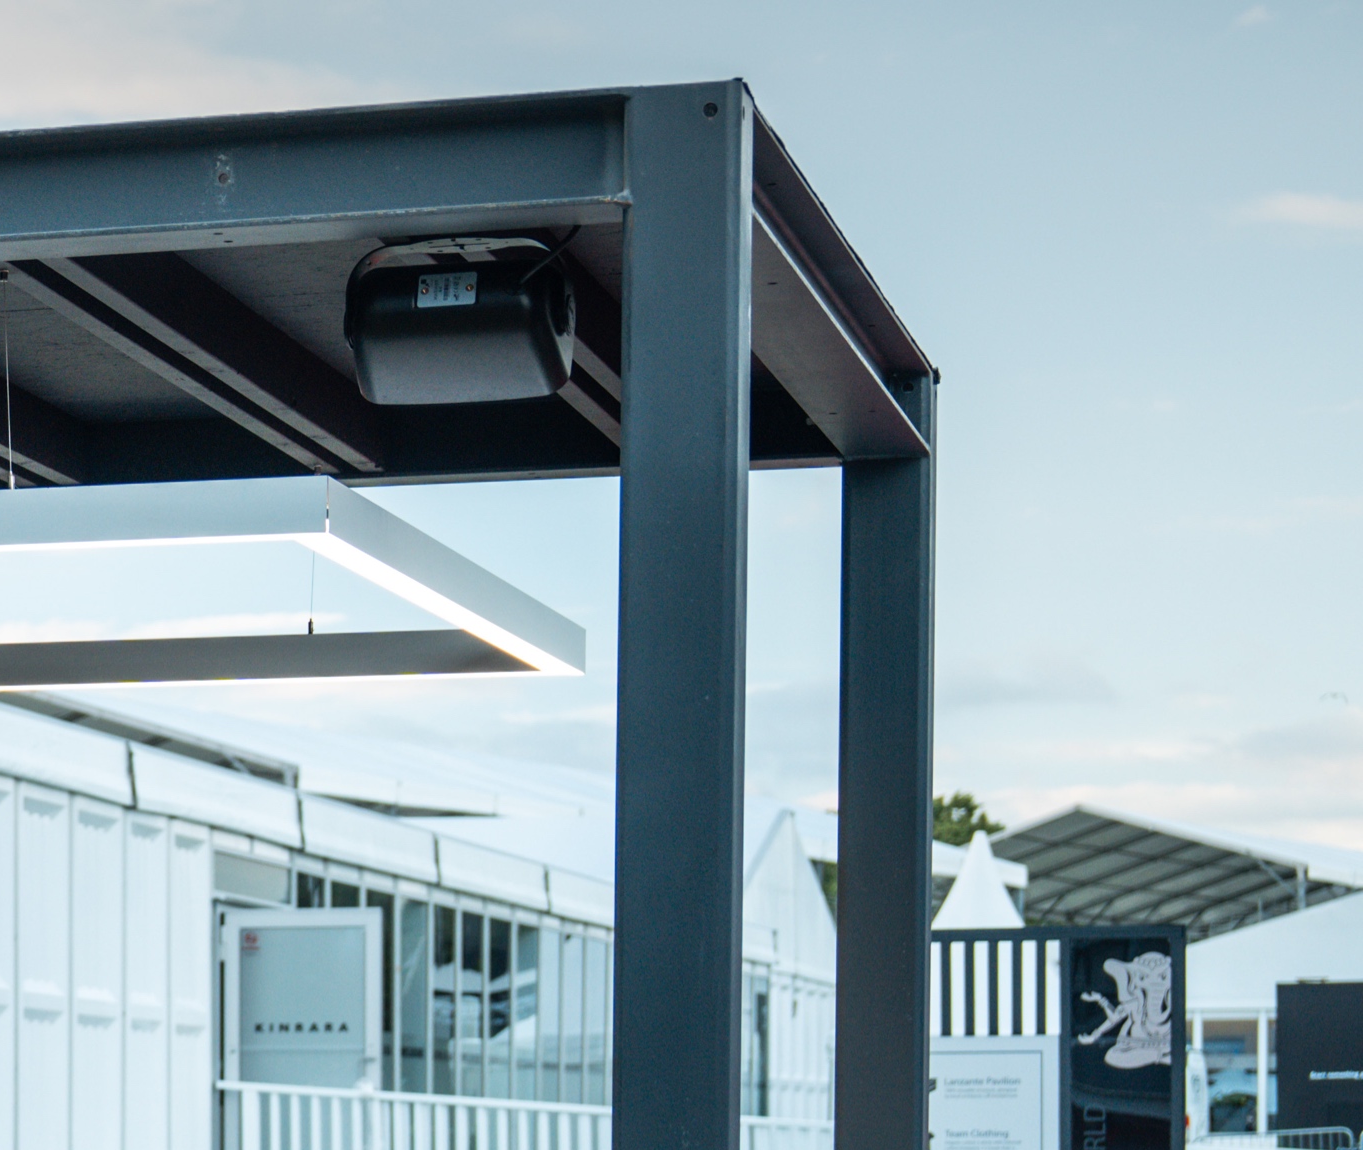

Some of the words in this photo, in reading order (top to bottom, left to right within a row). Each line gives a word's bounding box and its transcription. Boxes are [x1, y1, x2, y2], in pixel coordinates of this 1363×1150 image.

[986, 1076, 1022, 1086] Pavilion
[945, 1130, 968, 1138] Team
[971, 1129, 1010, 1139] Clothing
